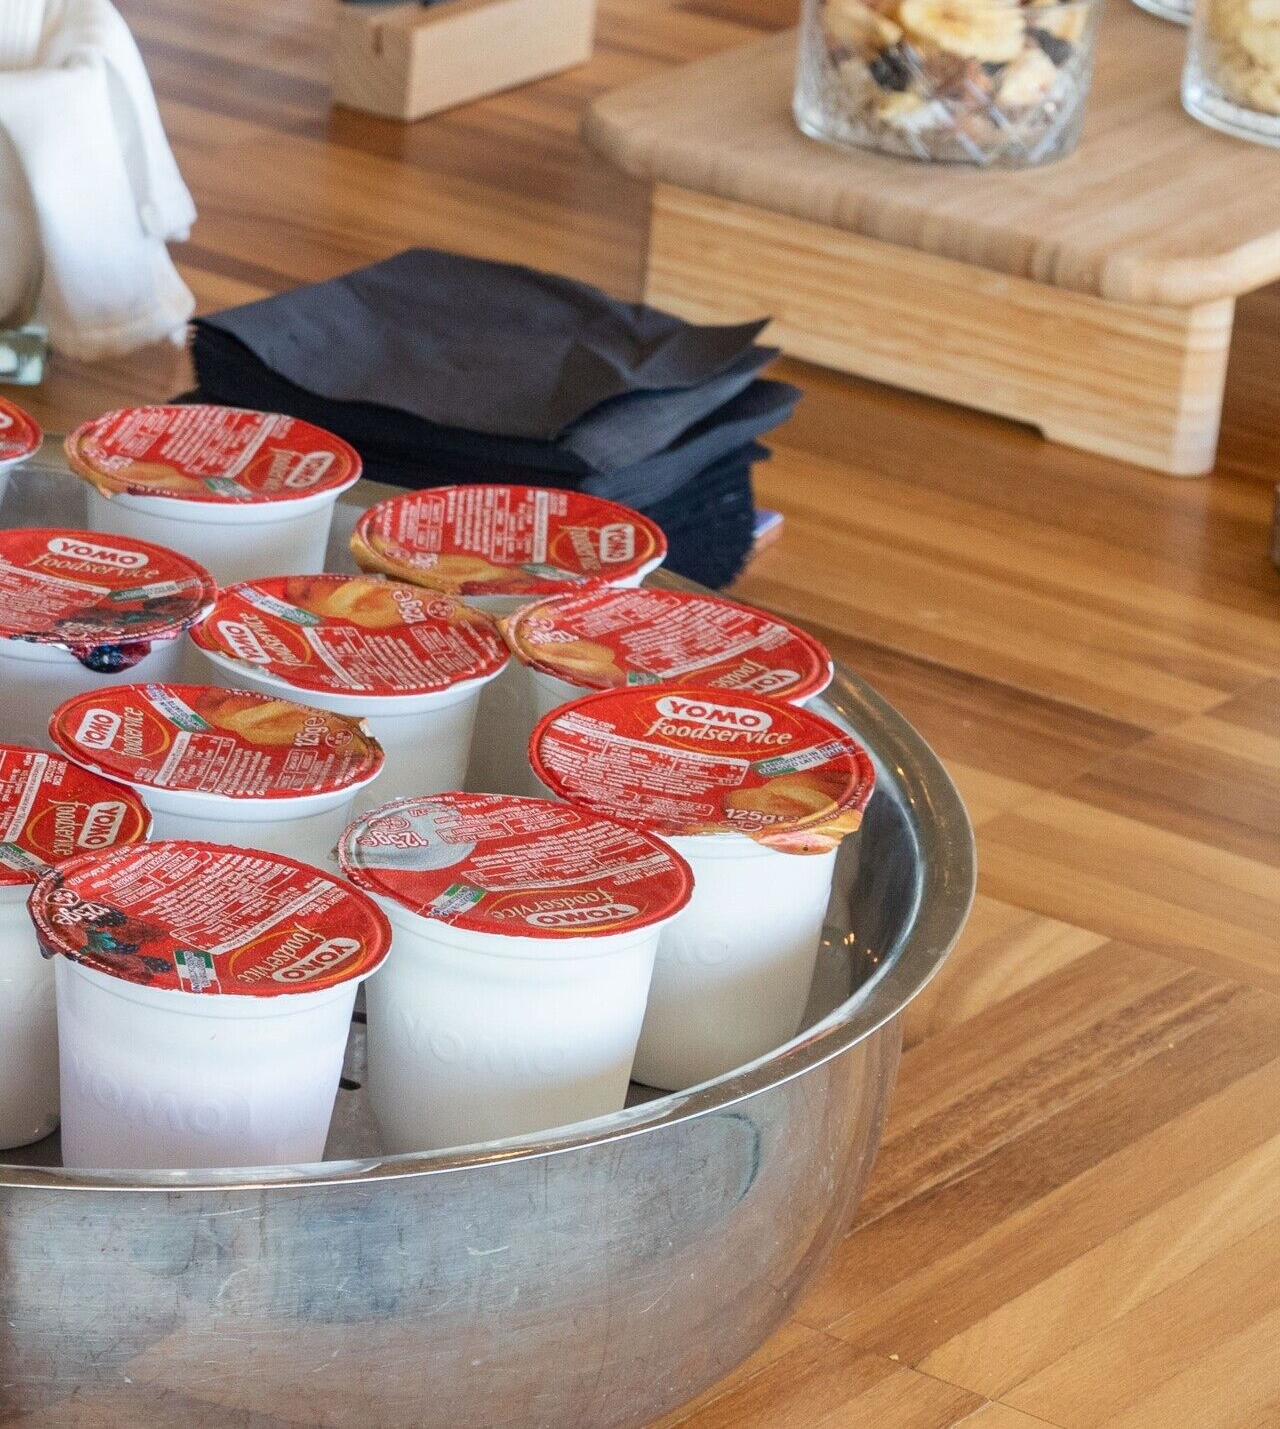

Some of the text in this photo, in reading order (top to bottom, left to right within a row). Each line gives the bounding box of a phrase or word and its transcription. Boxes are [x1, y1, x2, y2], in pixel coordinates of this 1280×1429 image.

[59, 541, 140, 565] YOMO
[80, 712, 113, 746] YOMO
[643, 716, 793, 745] foodservice
[669, 699, 762, 728] YOMO
[48, 798, 92, 856] foodservice
[84, 805, 122, 845] YOMO
[491, 886, 616, 920] foodservice
[536, 904, 633, 925] YOMO
[237, 921, 327, 984] foodservice
[285, 942, 356, 981] YOMO
